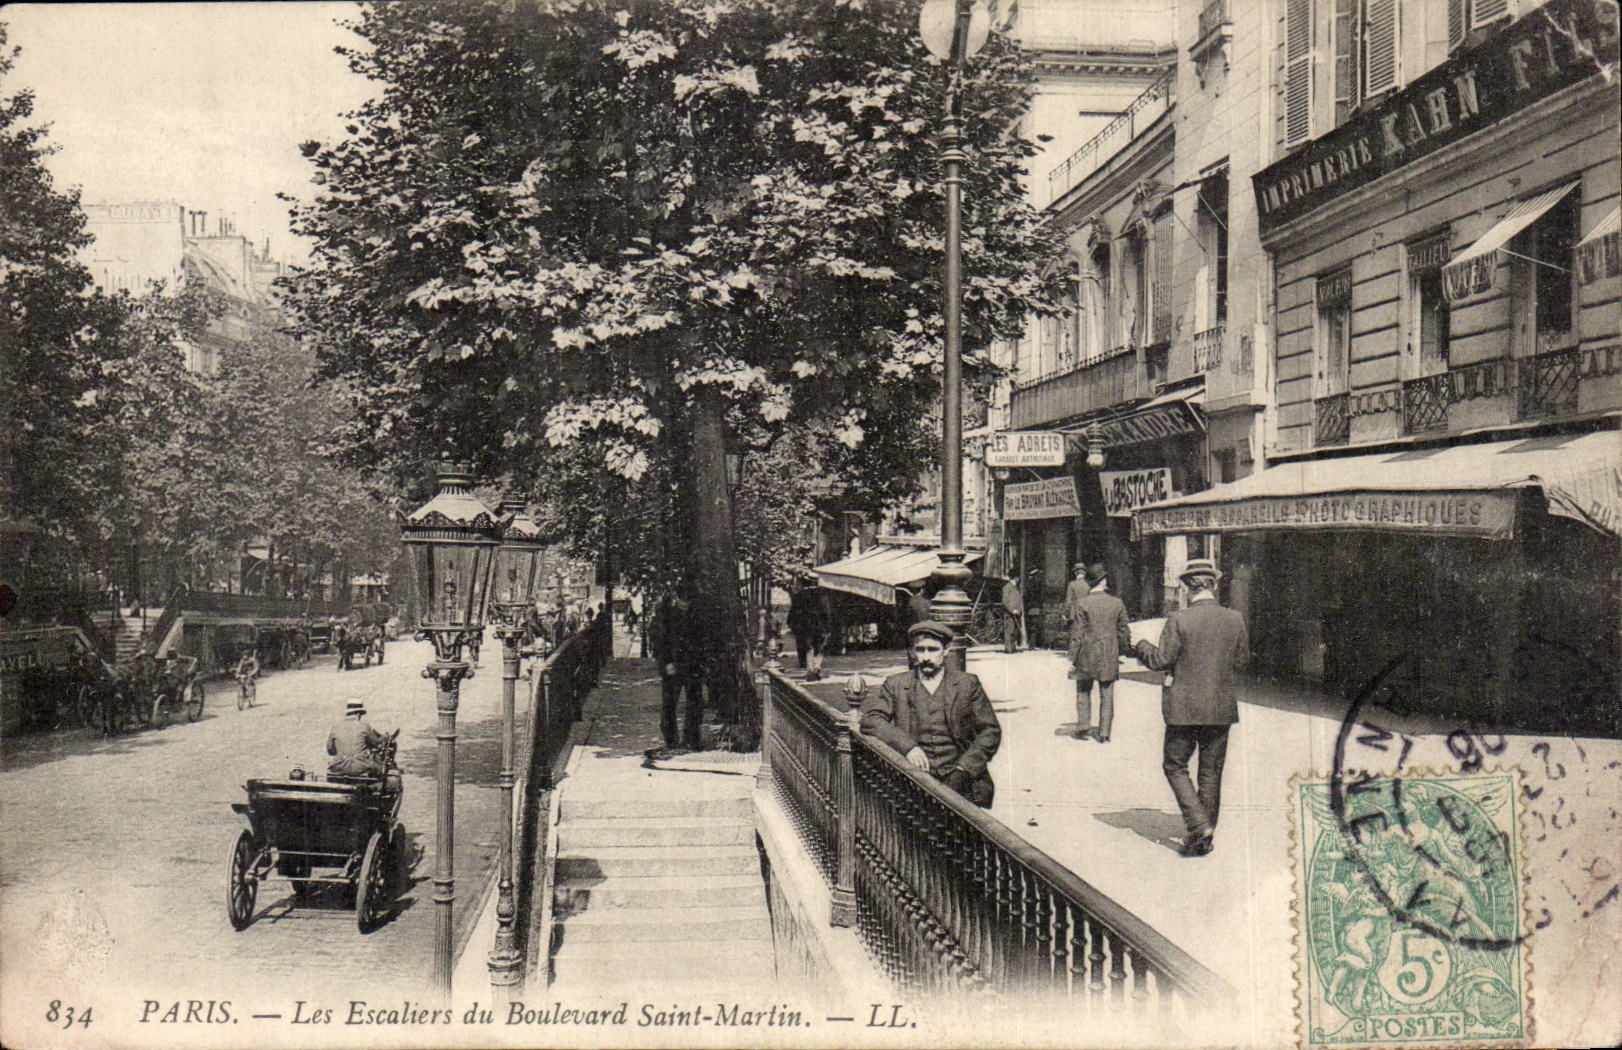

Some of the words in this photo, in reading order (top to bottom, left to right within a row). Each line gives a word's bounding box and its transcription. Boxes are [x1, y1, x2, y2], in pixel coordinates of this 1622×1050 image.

[1262, 136, 1373, 213] IMPRIMERIE
[1379, 70, 1480, 157] KAHN
[991, 435, 1009, 452] LES
[1017, 434, 1060, 453] ADRETS
[1066, 408, 1194, 453] AEXANDRE
[1295, 500, 1482, 527] PHOTOGRAPHIQUES
[1371, 1015, 1461, 1037] POSTES
